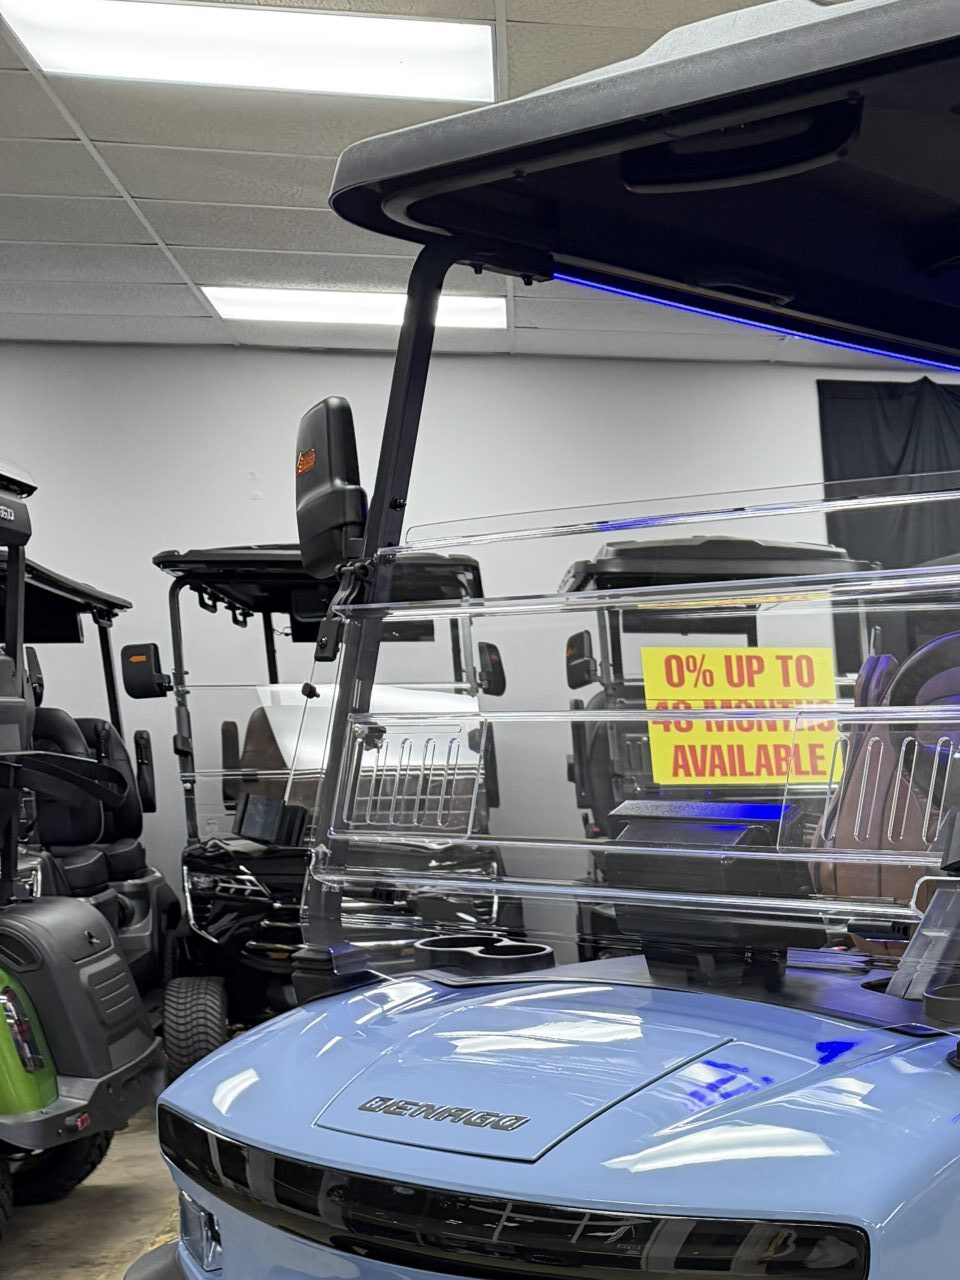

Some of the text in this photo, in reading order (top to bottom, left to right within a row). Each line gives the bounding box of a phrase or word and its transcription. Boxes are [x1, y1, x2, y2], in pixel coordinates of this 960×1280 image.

[664, 653, 815, 688] 0% UP TO
[672, 743, 828, 778] AVAILABLE
[358, 1095, 531, 1132] DENAGO
